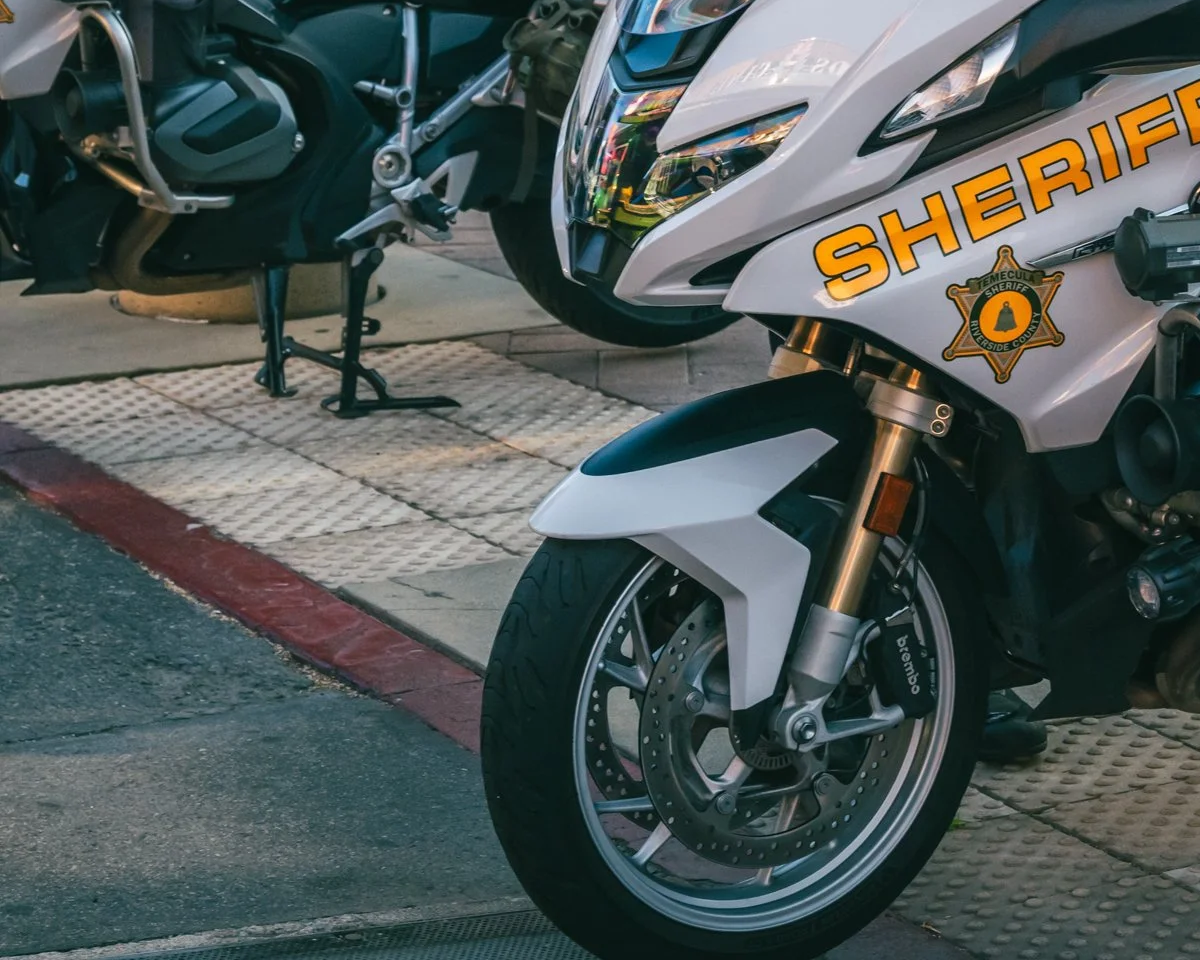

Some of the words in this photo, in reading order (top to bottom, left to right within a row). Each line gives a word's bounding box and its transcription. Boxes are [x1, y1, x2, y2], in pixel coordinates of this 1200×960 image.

[978, 270, 1035, 290] TEMECULA
[985, 281, 1029, 298] SHERIFF
[971, 320, 1009, 351] RIVERSIDE
[1012, 311, 1040, 348] COUNTY
[896, 634, 920, 695] brembo
